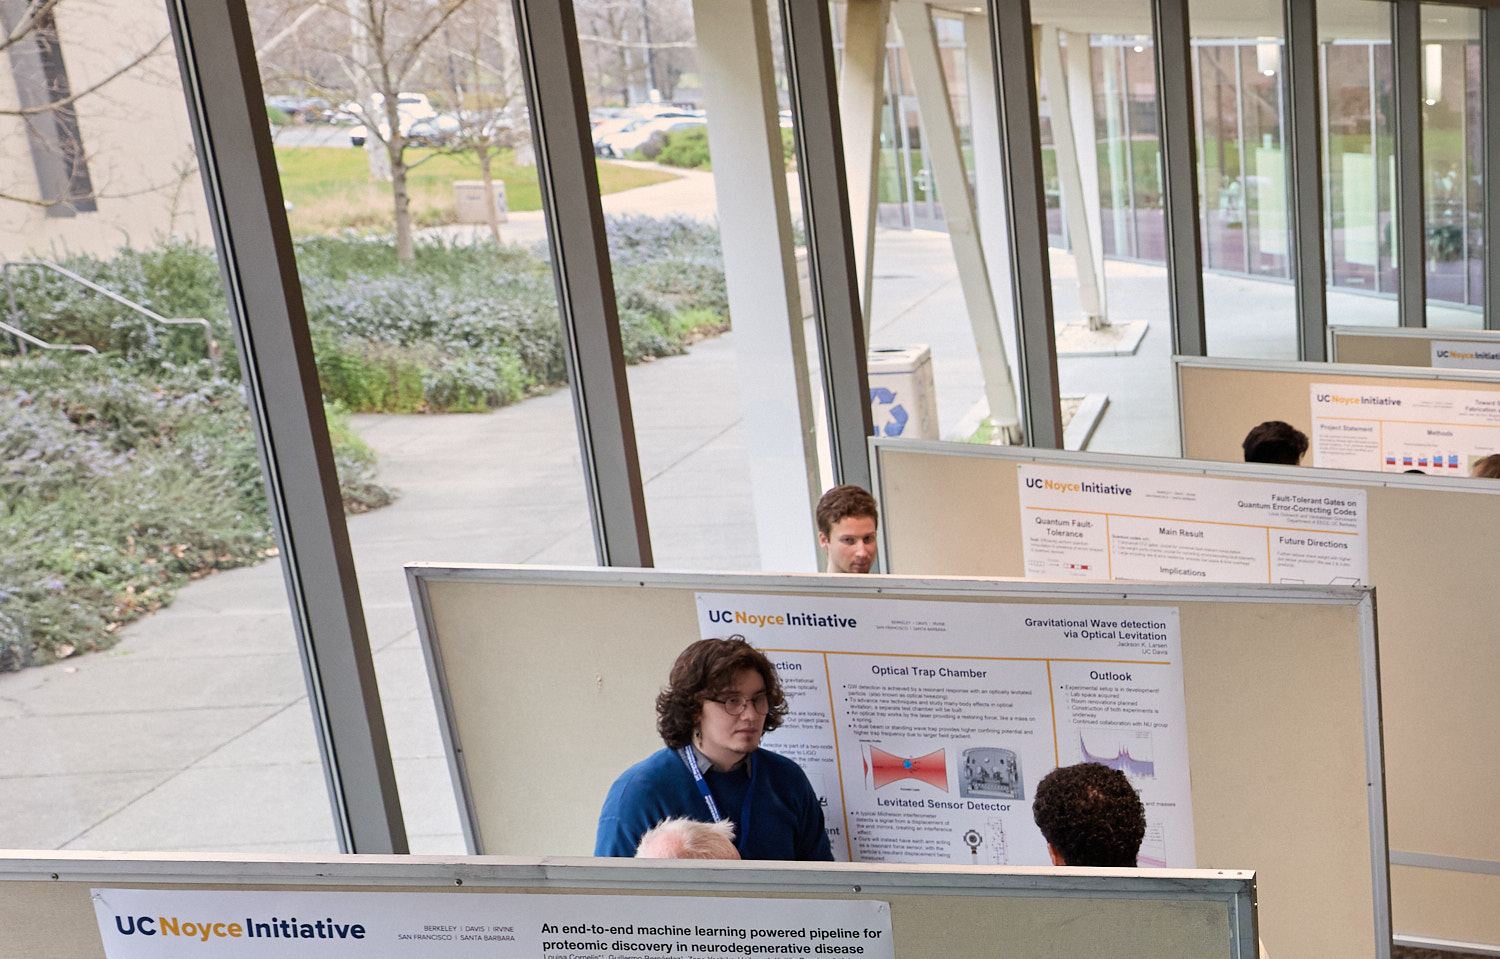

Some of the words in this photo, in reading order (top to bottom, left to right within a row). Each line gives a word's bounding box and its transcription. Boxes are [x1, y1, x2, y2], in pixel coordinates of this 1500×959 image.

[1437, 350, 1448, 358] UC
[1317, 394, 1330, 403] UC
[1361, 397, 1401, 406] Initiative
[1026, 478, 1043, 489] UC
[1045, 480, 1080, 493] Noyce
[1081, 482, 1132, 496] Initiative
[1272, 494, 1322, 505] Fault-Tolerant
[1323, 498, 1345, 506] Gates
[1237, 500, 1271, 509] Quantum
[1272, 503, 1332, 516] Error-Correcting
[1333, 507, 1357, 516] Codes
[1035, 516, 1070, 526] Quantum
[1072, 519, 1093, 528] Fault-
[1046, 528, 1083, 538] Tolerance
[1159, 527, 1177, 535] Main
[1179, 529, 1204, 538] Result
[1279, 536, 1305, 546] Future
[1307, 538, 1348, 549] Directions
[1160, 566, 1206, 577] Implications
[709, 610, 733, 624] UC
[735, 611, 784, 628] Noyce
[786, 613, 858, 629] Initiative
[1025, 618, 1088, 627] Gravitational
[1090, 619, 1118, 628] Wave
[1120, 620, 1166, 629] detection
[1063, 630, 1078, 638] via
[1081, 630, 1116, 640] Optical
[1118, 631, 1167, 641] Levitation
[871, 665, 909, 677] Optical
[911, 666, 936, 678] Trap
[939, 667, 987, 678] Chamber
[1090, 670, 1132, 681] Outlook
[877, 797, 925, 808] Levitated
[927, 799, 964, 809] Sensor
[967, 801, 1010, 811] Detector
[115, 916, 157, 936] UC
[159, 917, 243, 941] Noyce
[246, 917, 366, 939] Initiative
[541, 923, 559, 934] An
[562, 923, 634, 935] end-to-end
[637, 925, 691, 936] machine
[695, 925, 746, 940] learning
[750, 927, 806, 939] powered
[810, 927, 860, 940] pipeline
[863, 928, 882, 939] for
[543, 940, 608, 952] proteomic
[611, 940, 673, 954] discovery
[676, 941, 688, 952] in
[691, 942, 811, 955] neurodegenerative
[814, 943, 864, 954] disease
